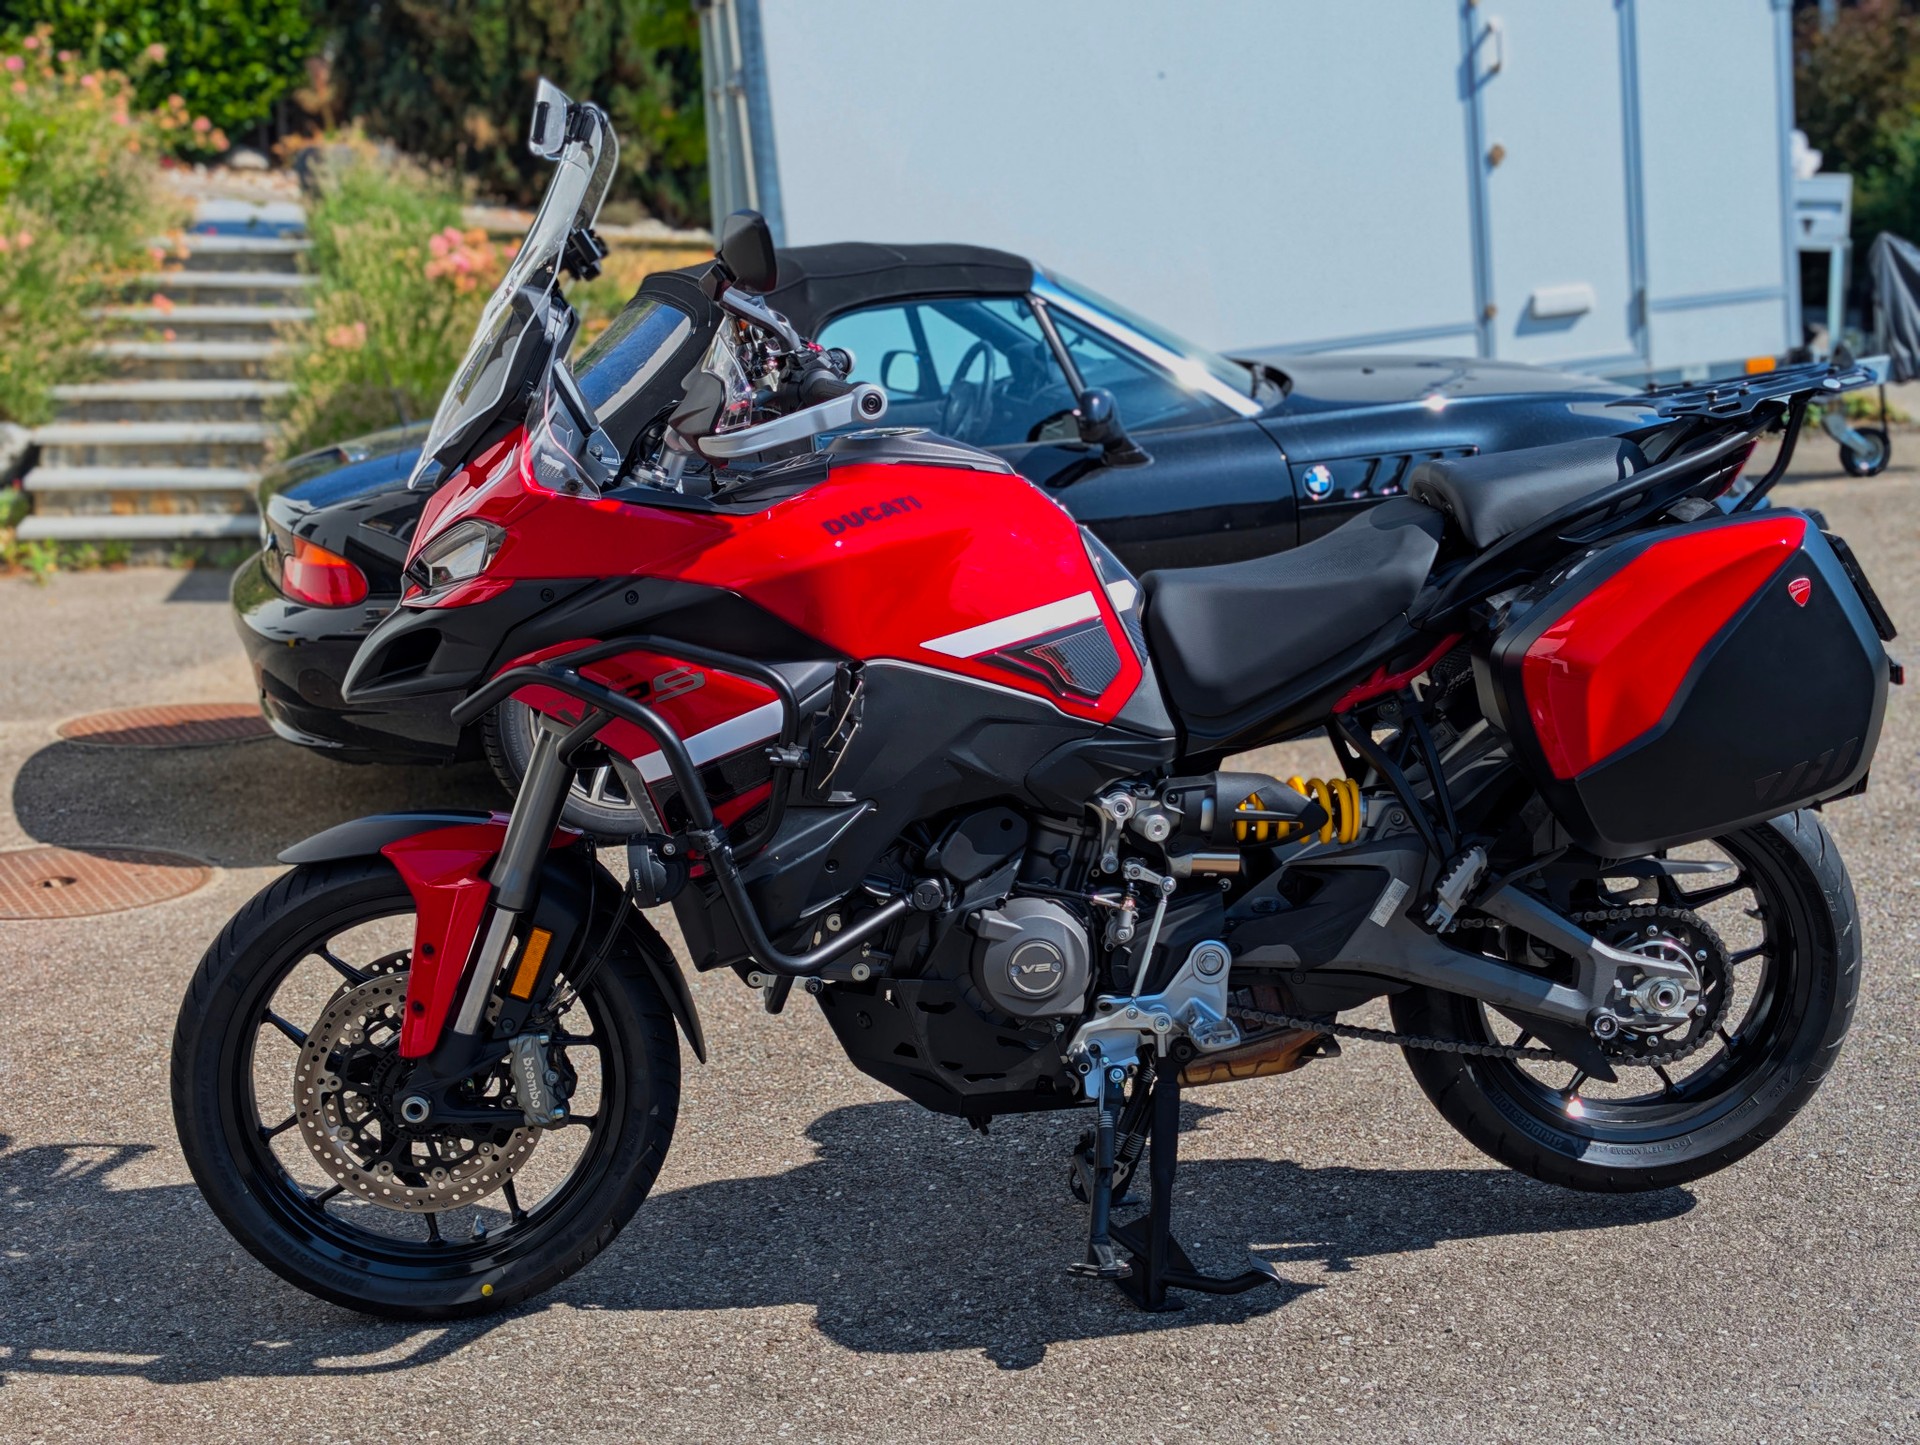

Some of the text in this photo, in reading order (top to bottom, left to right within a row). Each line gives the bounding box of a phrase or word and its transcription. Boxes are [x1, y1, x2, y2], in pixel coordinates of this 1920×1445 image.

[821, 496, 922, 536] DUCATI
[1021, 963, 1051, 974] V2
[522, 1056, 542, 1109] brembo
